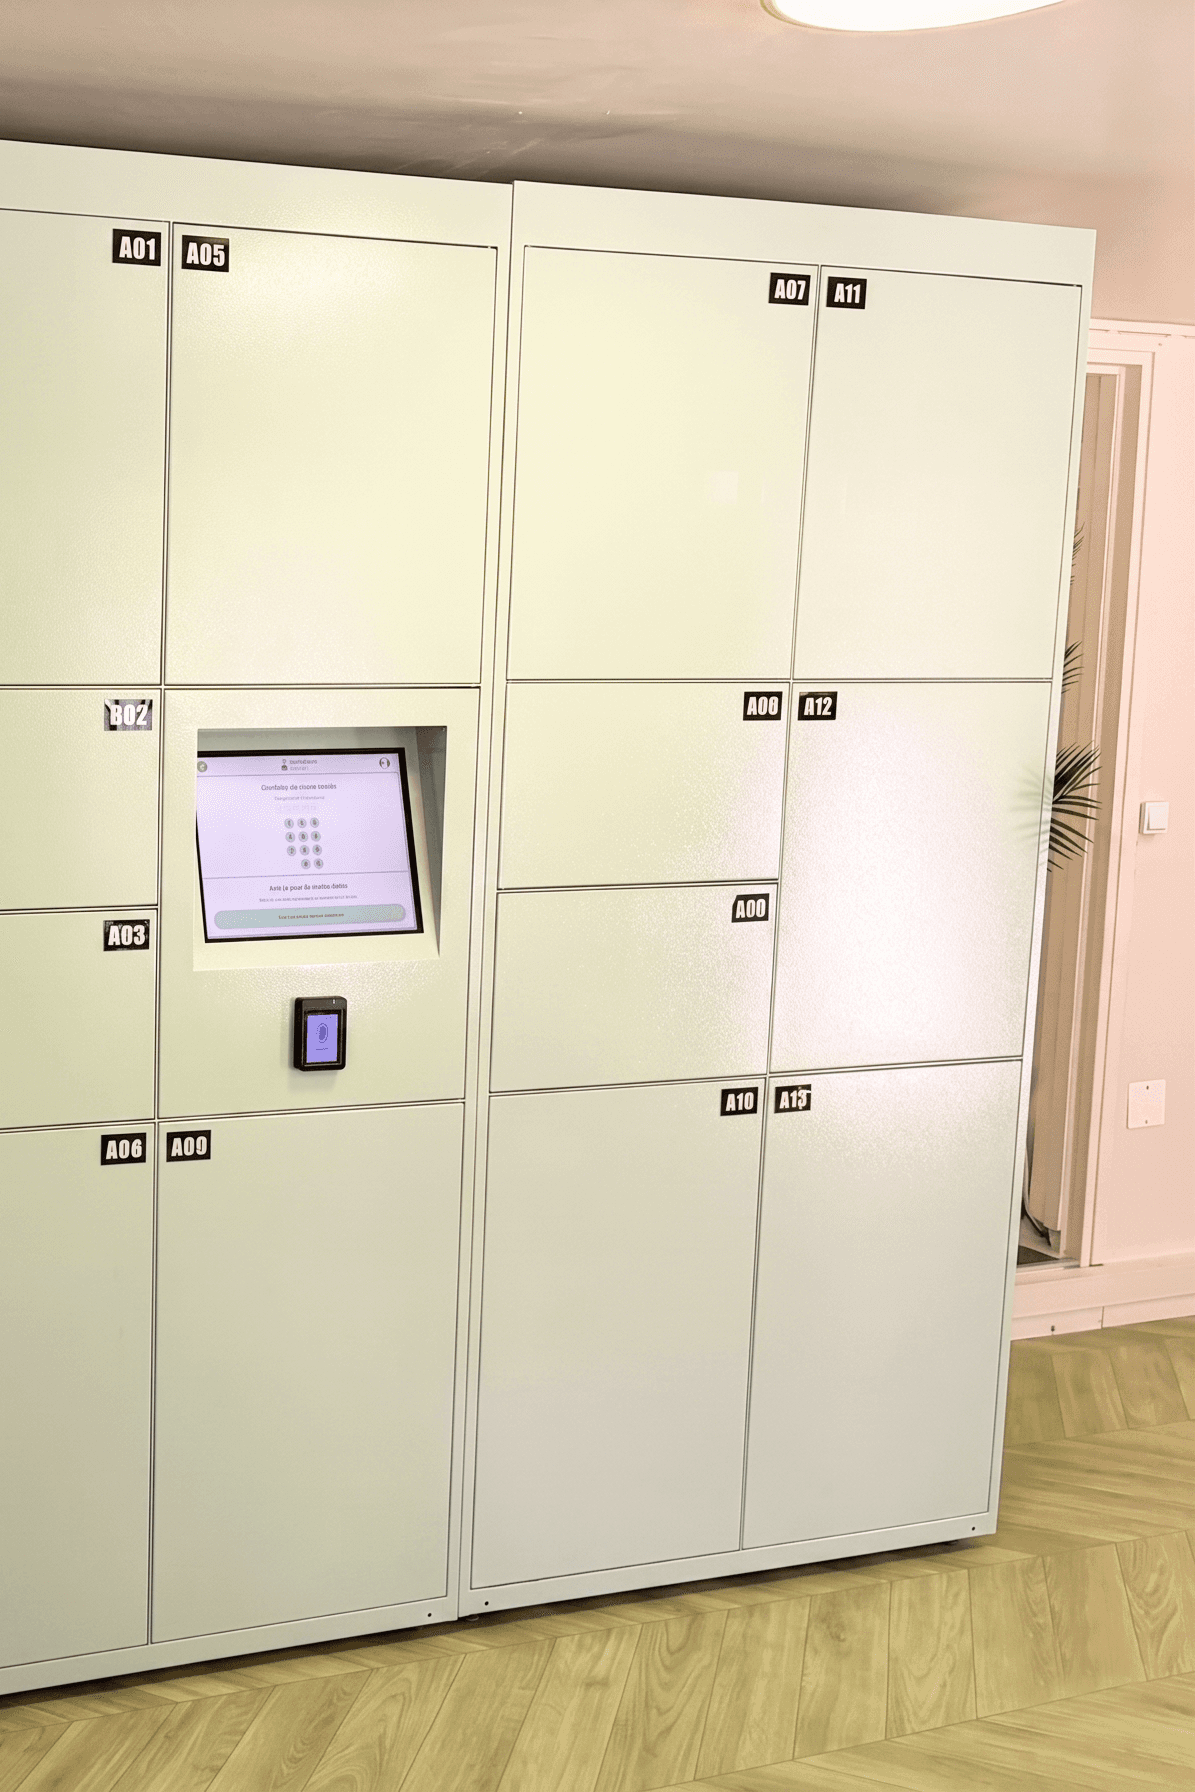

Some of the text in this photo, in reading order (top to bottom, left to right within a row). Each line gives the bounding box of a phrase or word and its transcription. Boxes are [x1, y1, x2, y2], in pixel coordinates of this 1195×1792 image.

[119, 236, 155, 260] A01
[187, 242, 225, 266] A05
[775, 279, 806, 299] A07
[835, 283, 861, 304] A11
[110, 704, 148, 725] B02
[805, 697, 833, 716] A12
[108, 925, 145, 946] A03
[726, 1092, 754, 1111] A10
[106, 1139, 142, 1160] A06
